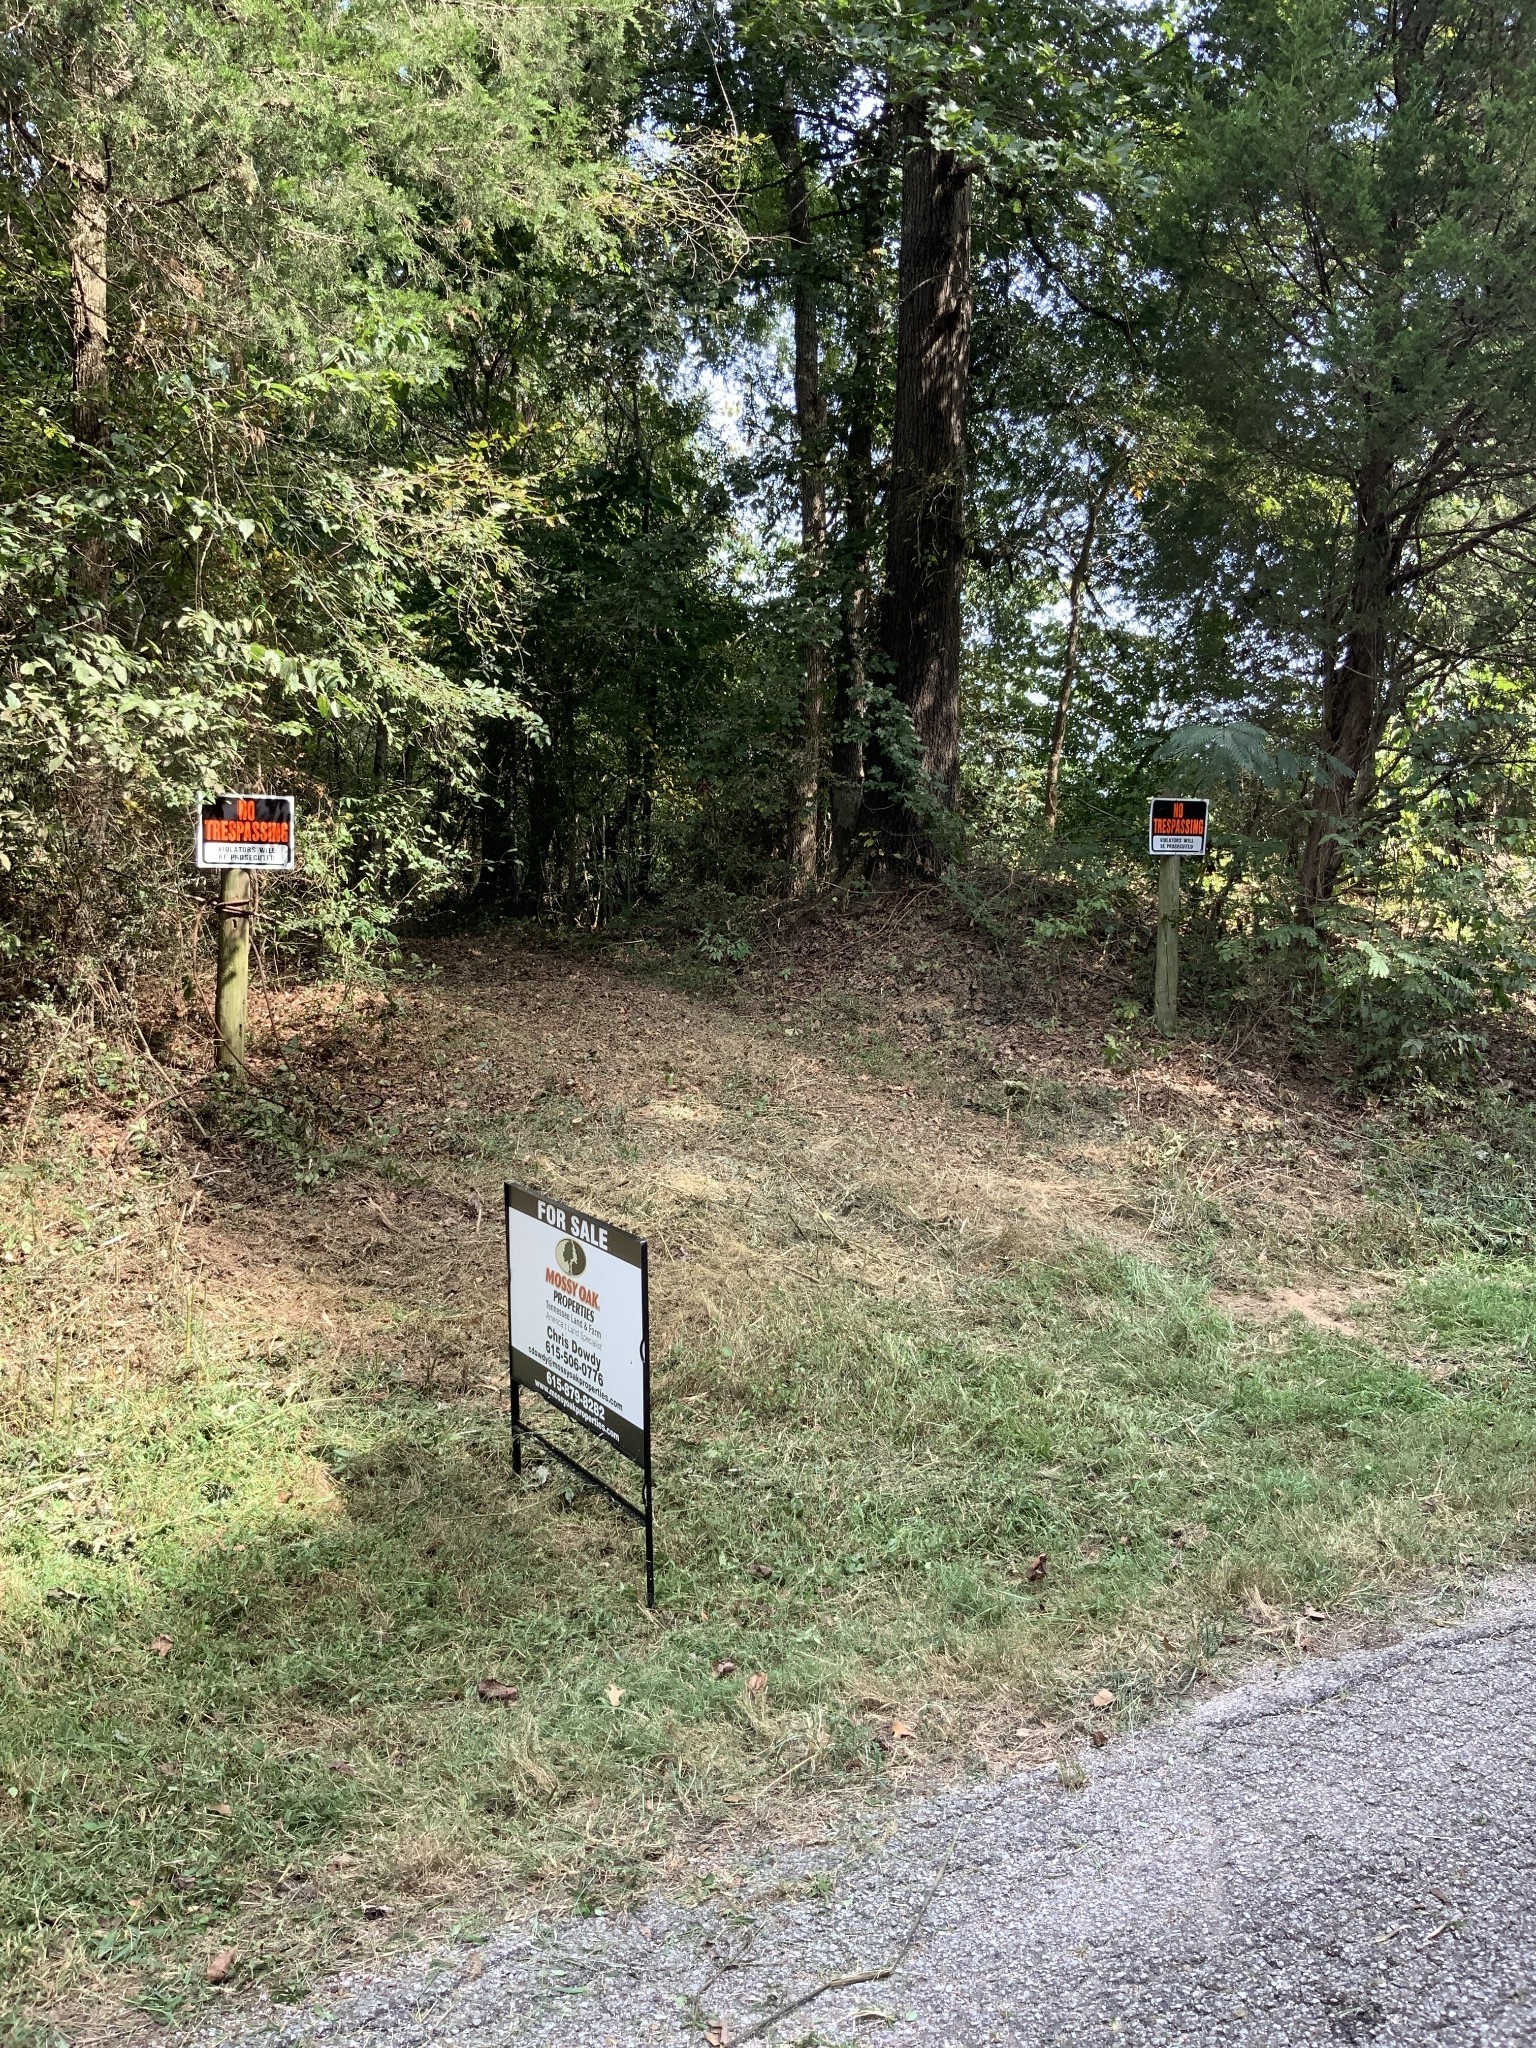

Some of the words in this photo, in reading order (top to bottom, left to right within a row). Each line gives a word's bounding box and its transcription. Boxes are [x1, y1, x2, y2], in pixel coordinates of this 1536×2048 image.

[237, 800, 255, 821] NO
[1153, 818, 1204, 835] TRESPASSING
[1173, 802, 1184, 818] NO
[204, 819, 288, 842] TRESPASSING
[537, 1200, 566, 1231] FOR
[570, 1215, 608, 1251] SALE
[545, 1267, 579, 1297] MOSSY
[579, 1285, 599, 1309] OAK
[553, 1290, 595, 1323] PROPERTIES
[545, 1300, 570, 1321] Tennessee
[570, 1313, 583, 1328] Land
[583, 1321, 588, 1331] &
[588, 1324, 602, 1339] Farm
[567, 1323, 580, 1337] Land
[545, 1341, 604, 1387] 615-506-0776
[546, 1326, 569, 1349] Chris
[571, 1340, 601, 1372] Dowdy
[528, 1346, 623, 1411] cdowdy@mossyoakproperties.com
[546, 1371, 605, 1421] 615-879-8282
[534, 1379, 620, 1442] www.mossyoakproperties.com
